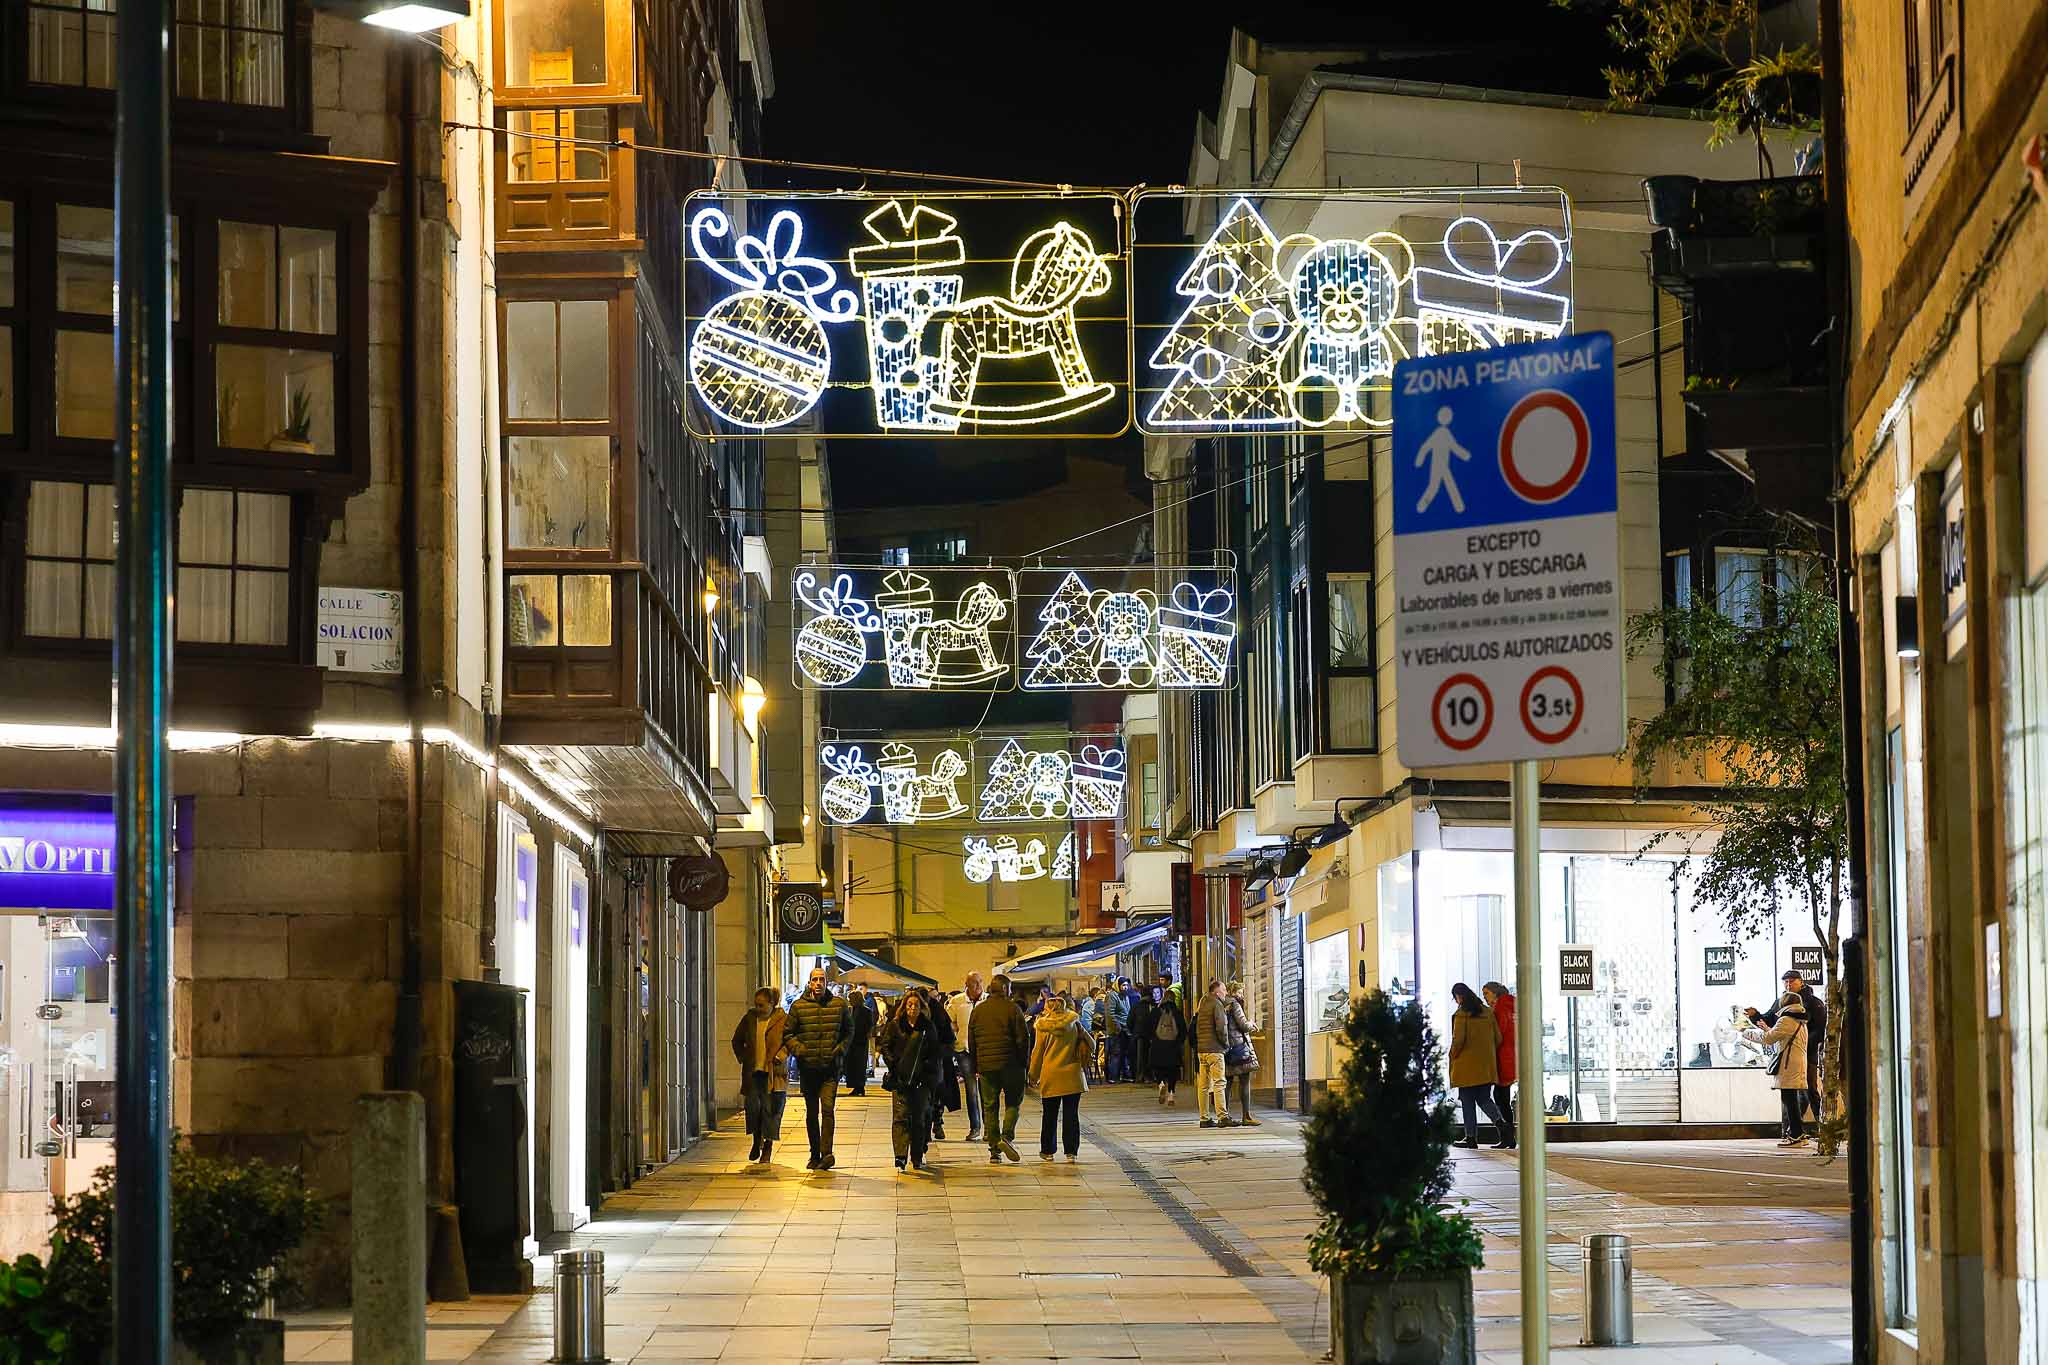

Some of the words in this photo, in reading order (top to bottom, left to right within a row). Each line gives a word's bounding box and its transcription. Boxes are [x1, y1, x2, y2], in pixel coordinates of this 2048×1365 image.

[1403, 365, 1469, 395] ZONA
[1476, 347, 1600, 385] PEATONAL
[1467, 529, 1541, 554] EXCEPTO
[1423, 564, 1478, 586] CARGA
[1483, 562, 1494, 579] Y
[1499, 552, 1587, 578] DESCARGA
[1401, 592, 1478, 613] Laborables
[1482, 588, 1499, 605] de
[1504, 585, 1542, 602] lunes
[1547, 586, 1556, 599] a
[1560, 579, 1613, 597] viernes
[320, 599, 362, 610] CALLE
[1402, 651, 1412, 667] Y
[1415, 642, 1499, 666] VEHÍCULOS
[1503, 631, 1613, 658] AUTORIZADOS
[1447, 696, 1478, 726] 10
[1563, 955, 1589, 968] BLACK
[1707, 951, 1732, 964] BLACK
[1794, 951, 1820, 964] BLACK
[1563, 973, 1591, 985] FRIDAY
[1706, 969, 1734, 981] FRIDAY
[1800, 968, 1822, 981] RIDAY
